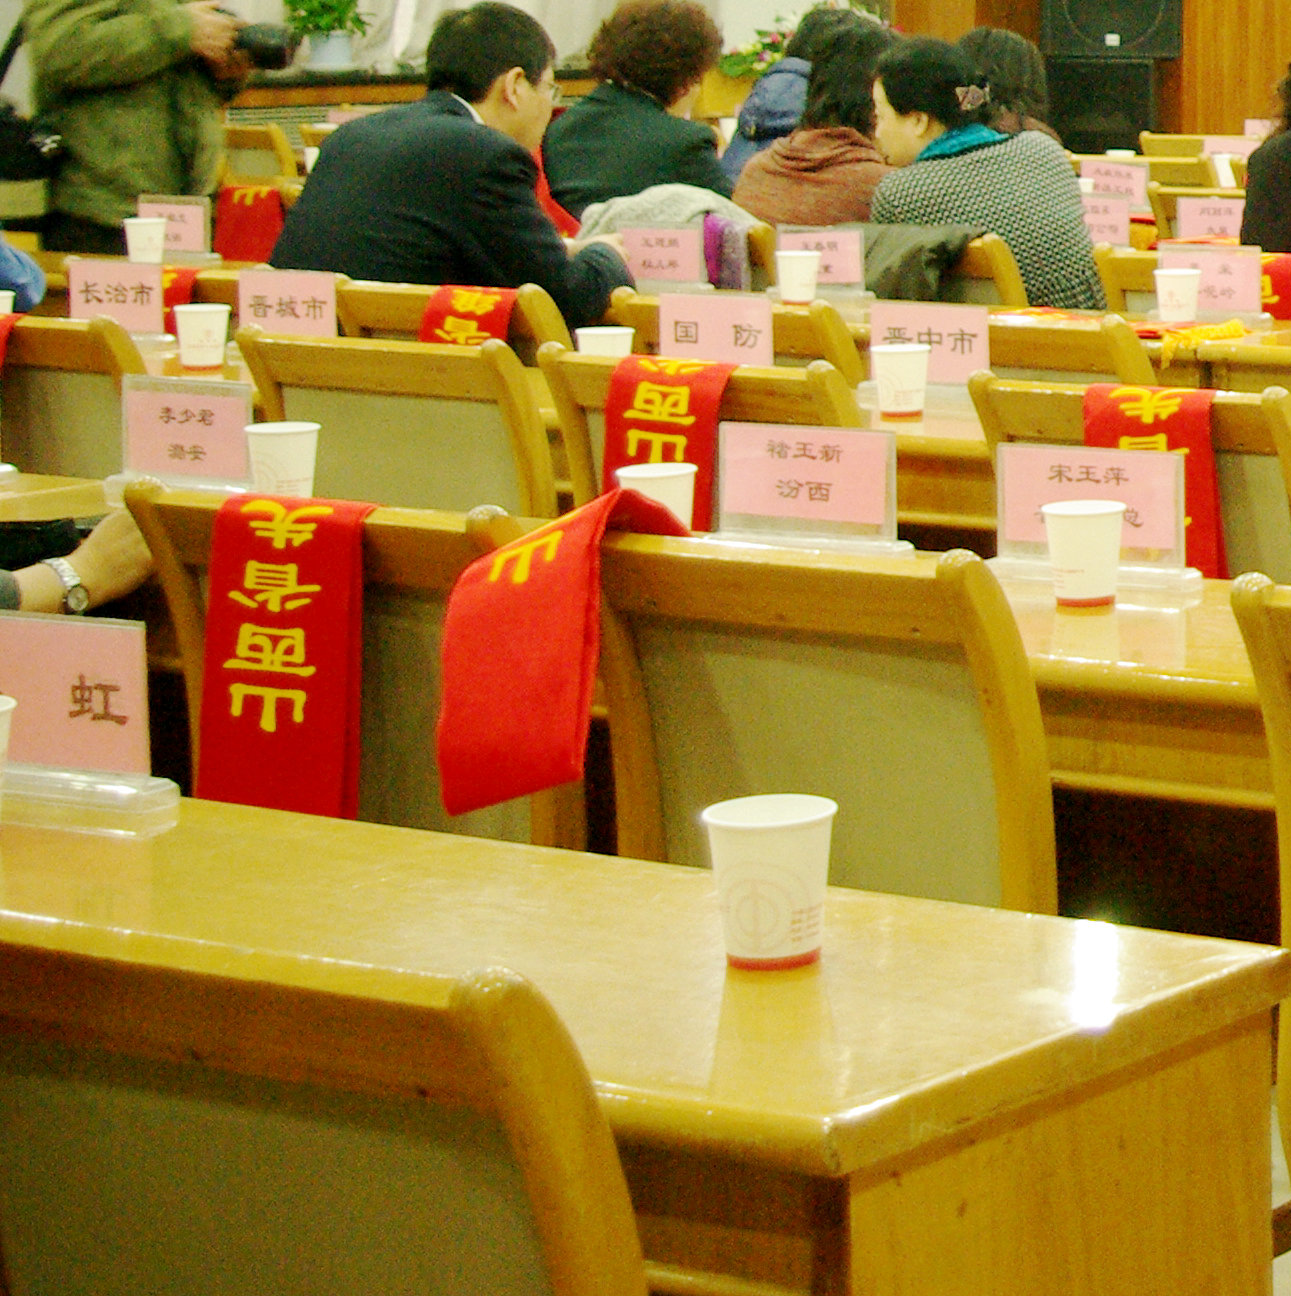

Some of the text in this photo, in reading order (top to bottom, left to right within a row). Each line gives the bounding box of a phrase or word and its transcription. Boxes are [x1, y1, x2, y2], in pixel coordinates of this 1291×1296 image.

[79, 281, 154, 306] 长治市
[249, 294, 328, 321] 晋城市
[158, 406, 214, 426] 李少君
[1048, 464, 1130, 486] 宋玉萍
[775, 479, 832, 503] 汾西
[222, 498, 335, 733] 山西省先
